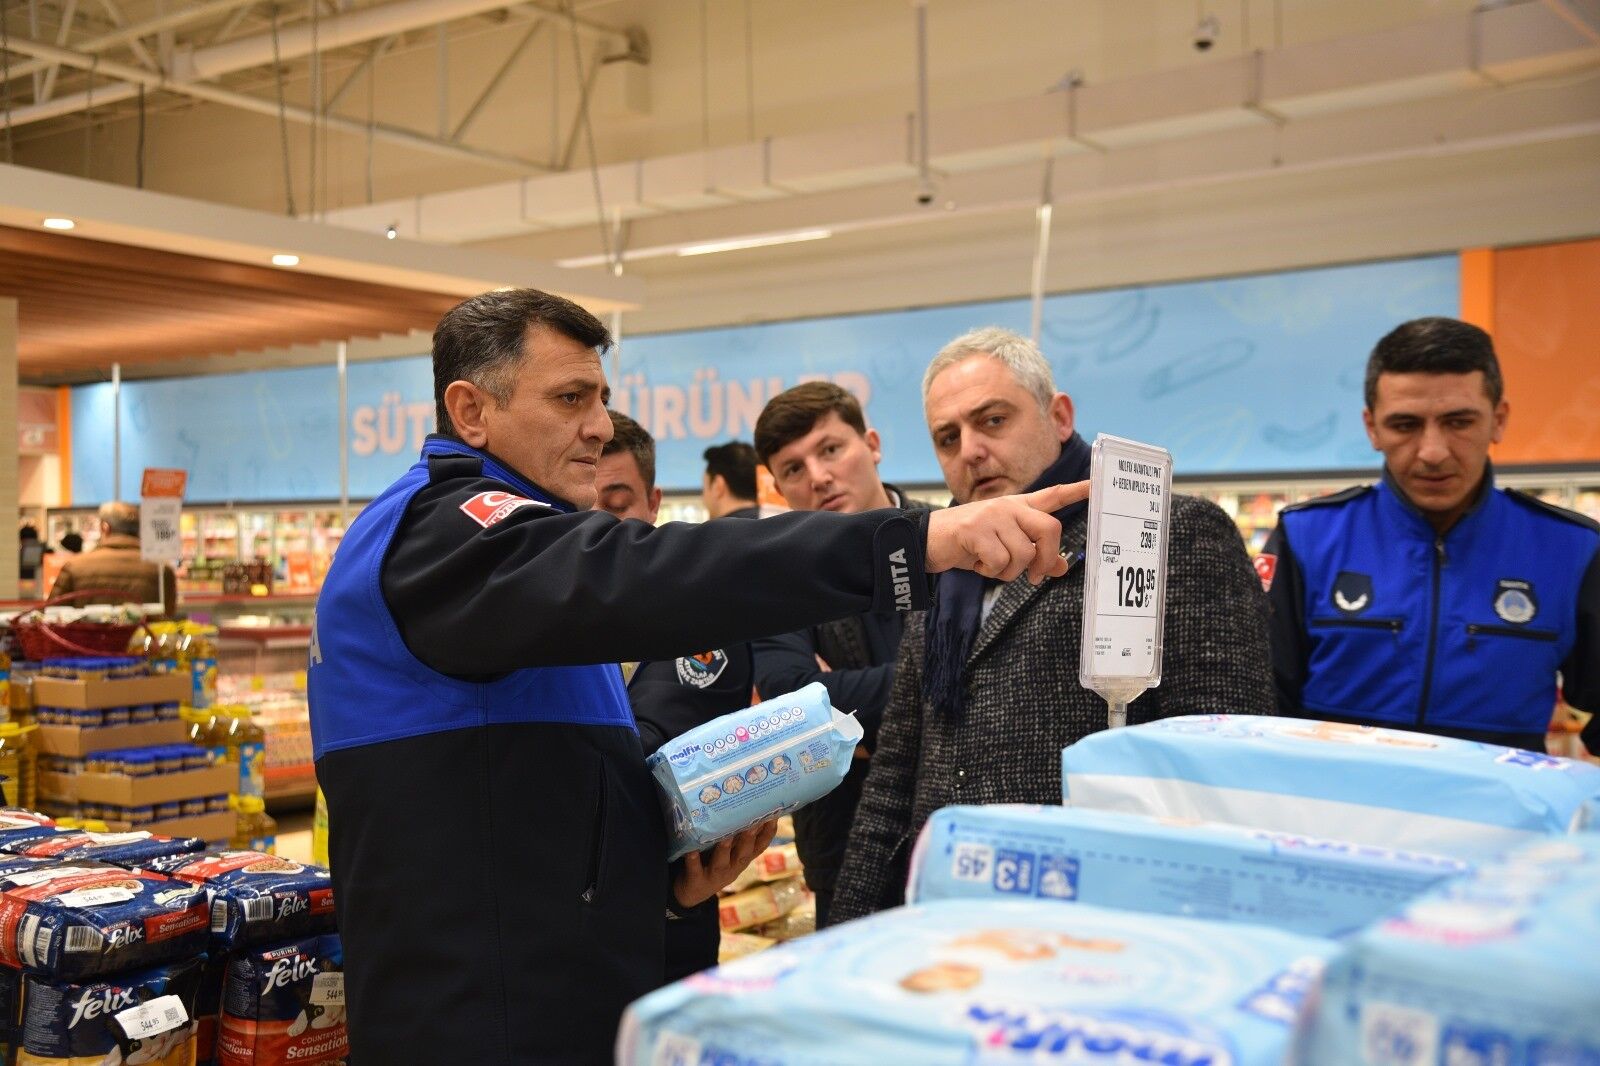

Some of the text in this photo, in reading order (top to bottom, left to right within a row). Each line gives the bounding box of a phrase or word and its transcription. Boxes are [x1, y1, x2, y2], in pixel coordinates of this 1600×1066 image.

[669, 743, 702, 762] molfix
[275, 896, 308, 922] felix
[103, 926, 144, 955] felix
[271, 948, 298, 958] PURINA
[261, 954, 317, 996] felix
[67, 986, 134, 1030] felix
